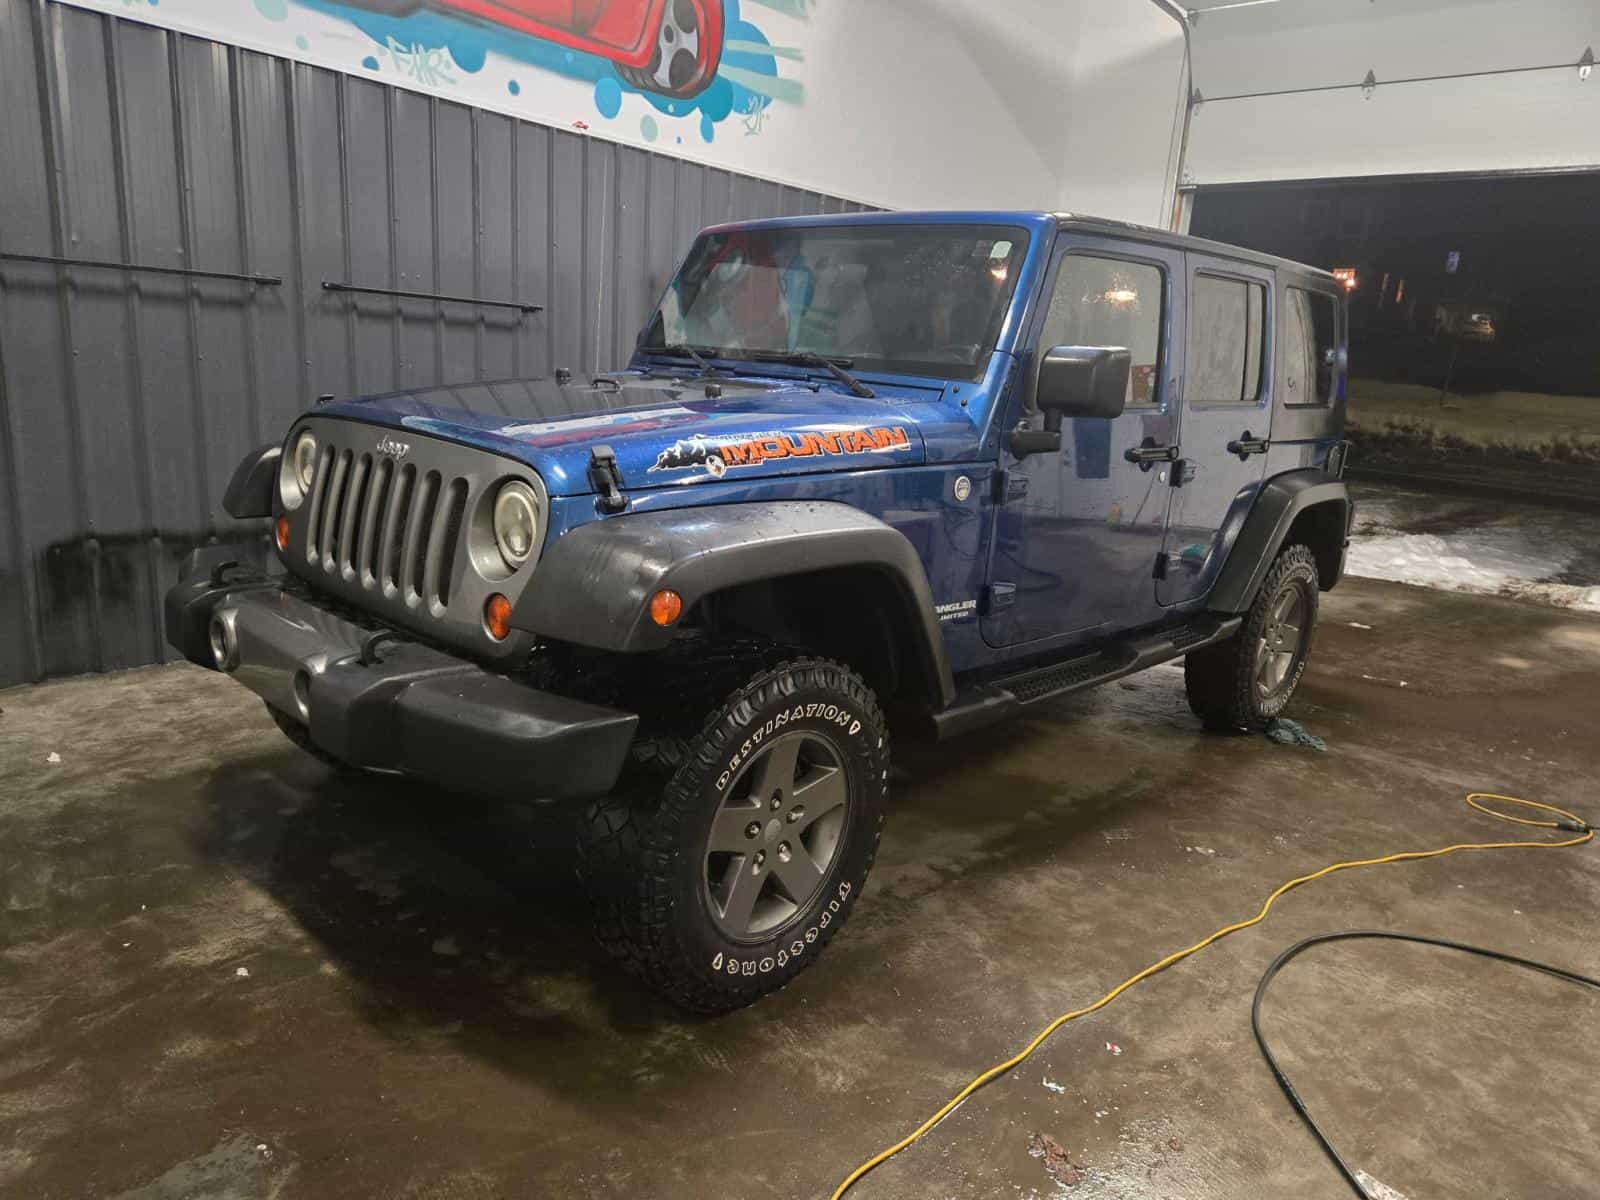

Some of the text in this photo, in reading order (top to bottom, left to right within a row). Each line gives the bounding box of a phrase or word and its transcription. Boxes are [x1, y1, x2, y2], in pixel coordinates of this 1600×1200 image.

[376, 434, 410, 461] Jeep
[719, 426, 910, 466] MOUNTAIN
[935, 599, 976, 613] ANGLER
[715, 703, 851, 791] DESTINATION
